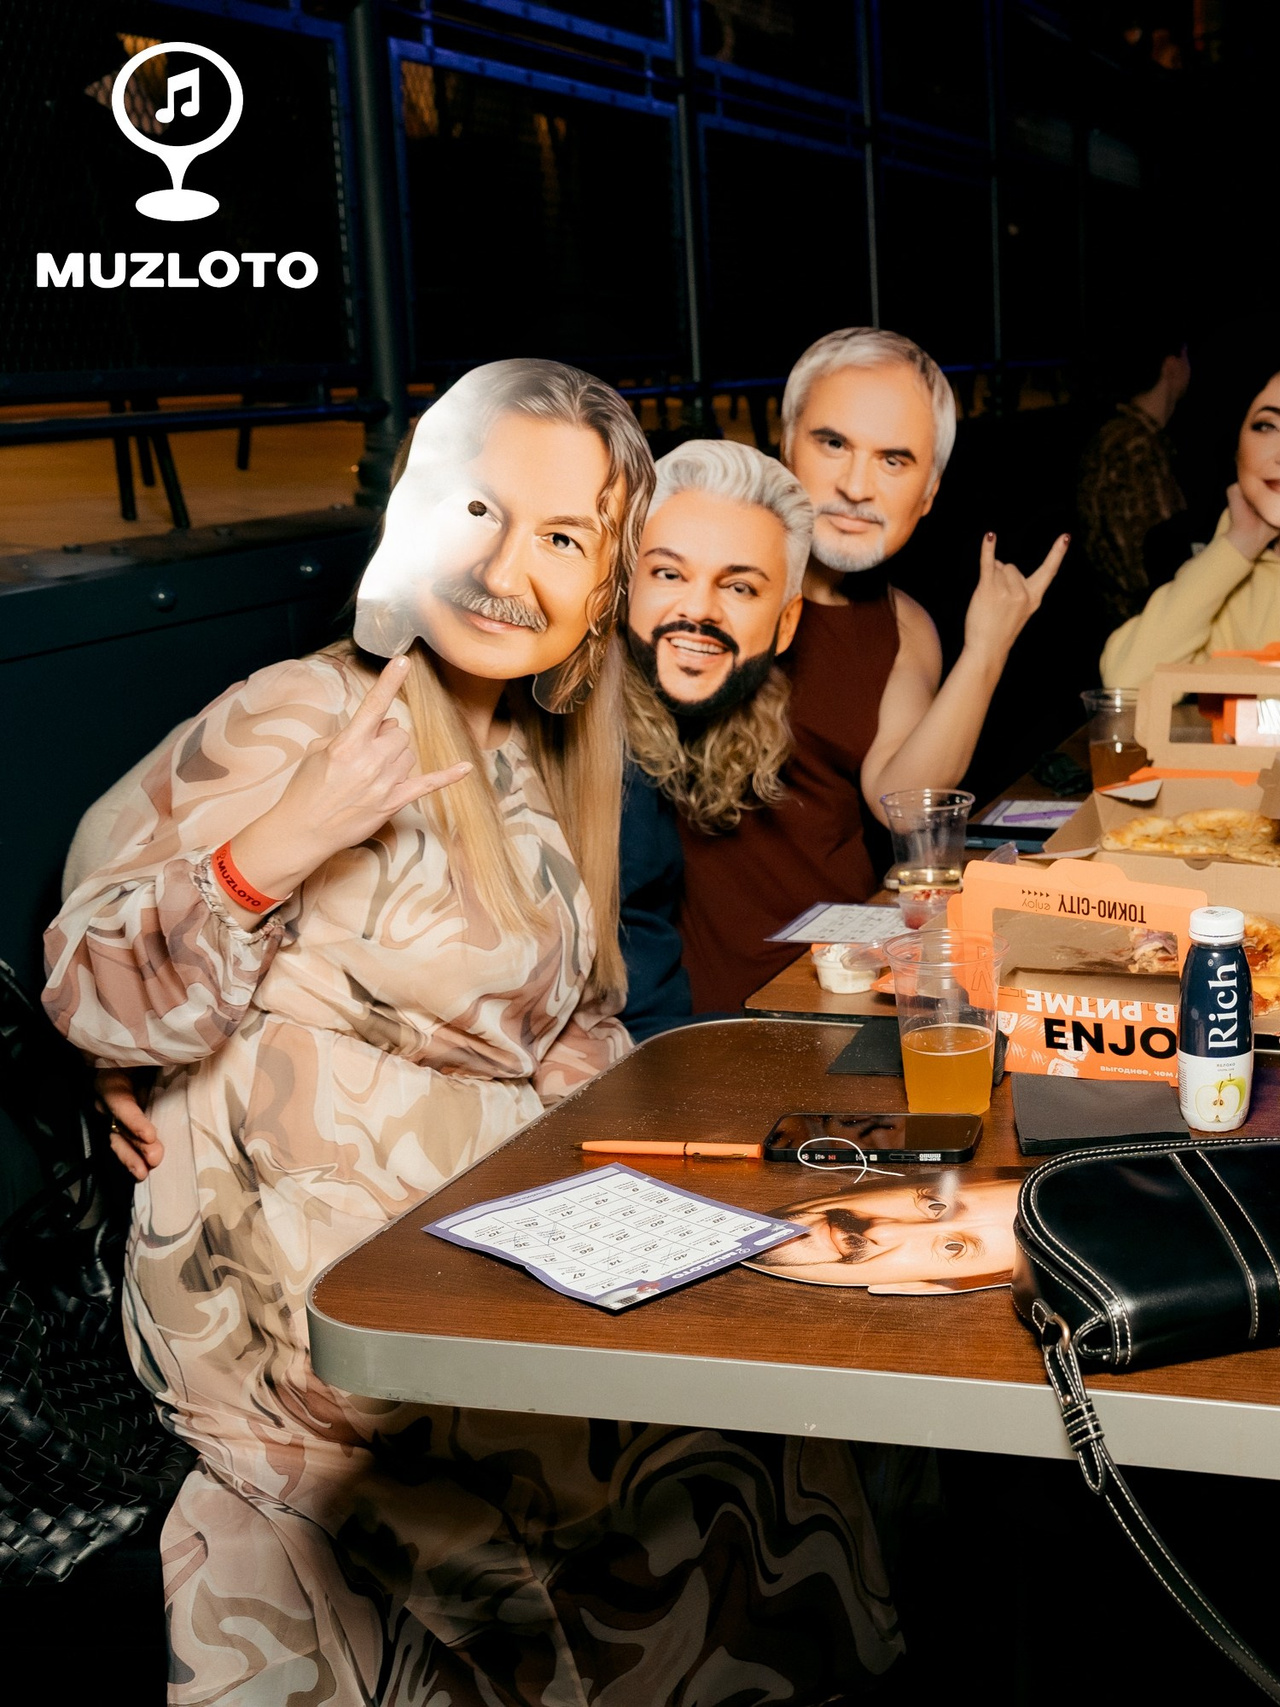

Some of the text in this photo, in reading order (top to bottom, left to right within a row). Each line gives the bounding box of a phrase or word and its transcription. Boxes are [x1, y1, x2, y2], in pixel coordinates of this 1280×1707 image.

[217, 860, 261, 907] MUZLOTO
[1021, 898, 1050, 912] enjoy
[1025, 989, 1142, 1022] РИТМЕ
[1208, 960, 1238, 1050] Rich
[1100, 1065, 1174, 1078] выгоднее, чем
[580, 1247, 594, 1255] 56
[644, 1244, 659, 1252] 20
[671, 1251, 738, 1279] MUZLOTO
[572, 1272, 586, 1280] 47
